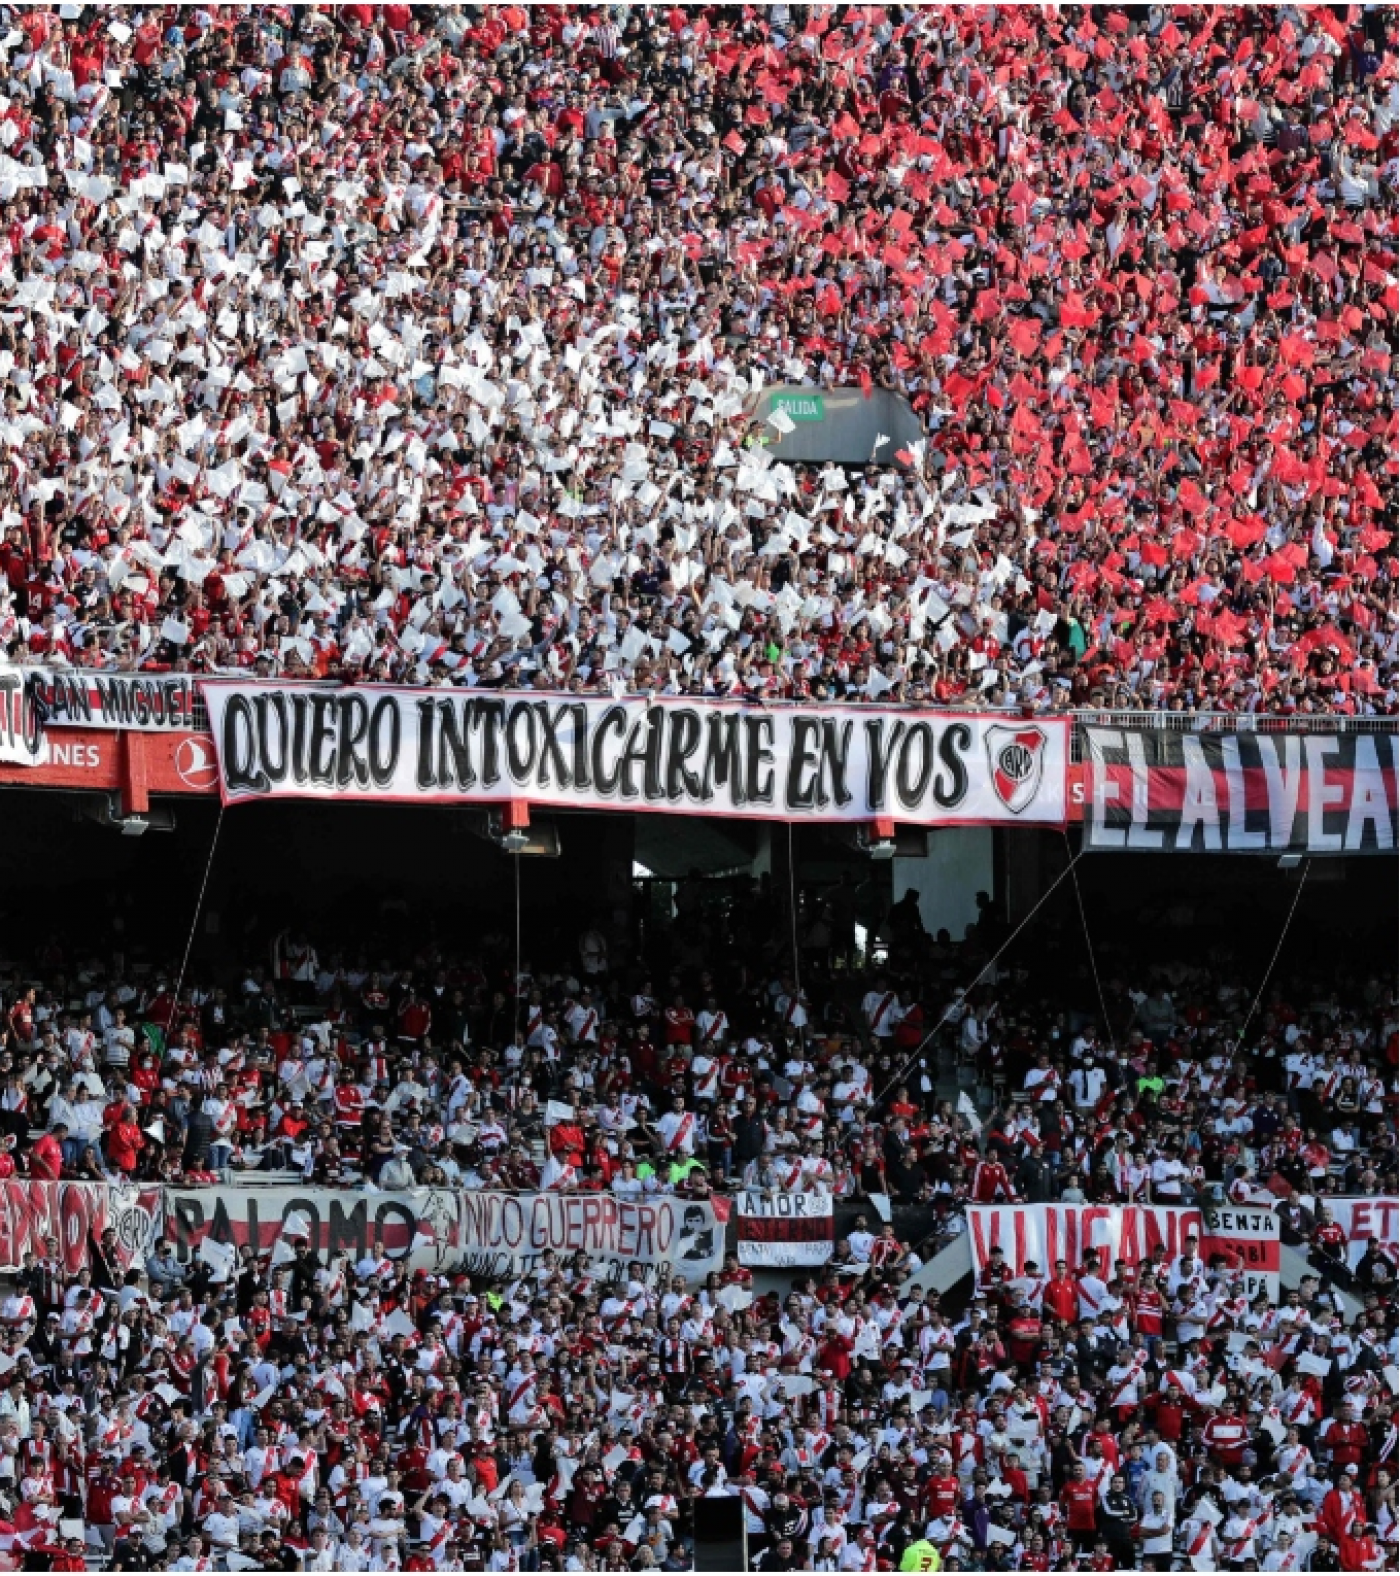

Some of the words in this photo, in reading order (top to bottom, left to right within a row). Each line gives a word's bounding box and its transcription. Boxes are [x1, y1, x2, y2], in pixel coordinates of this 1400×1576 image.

[776, 399, 818, 416] SALIDA
[0, 672, 44, 755] TO
[94, 676, 193, 726] MIGUEL
[223, 690, 401, 794] QUIERO
[414, 694, 775, 806] INTOXICARME
[785, 714, 852, 812] EN
[864, 716, 972, 812] VOS
[1086, 728, 1163, 847] EL
[1175, 734, 1399, 852] ALVEA
[174, 1196, 417, 1264] PALOMO
[463, 1192, 524, 1248] NICO
[530, 1195, 675, 1257] GUERRERO
[743, 1192, 808, 1216] AMOR
